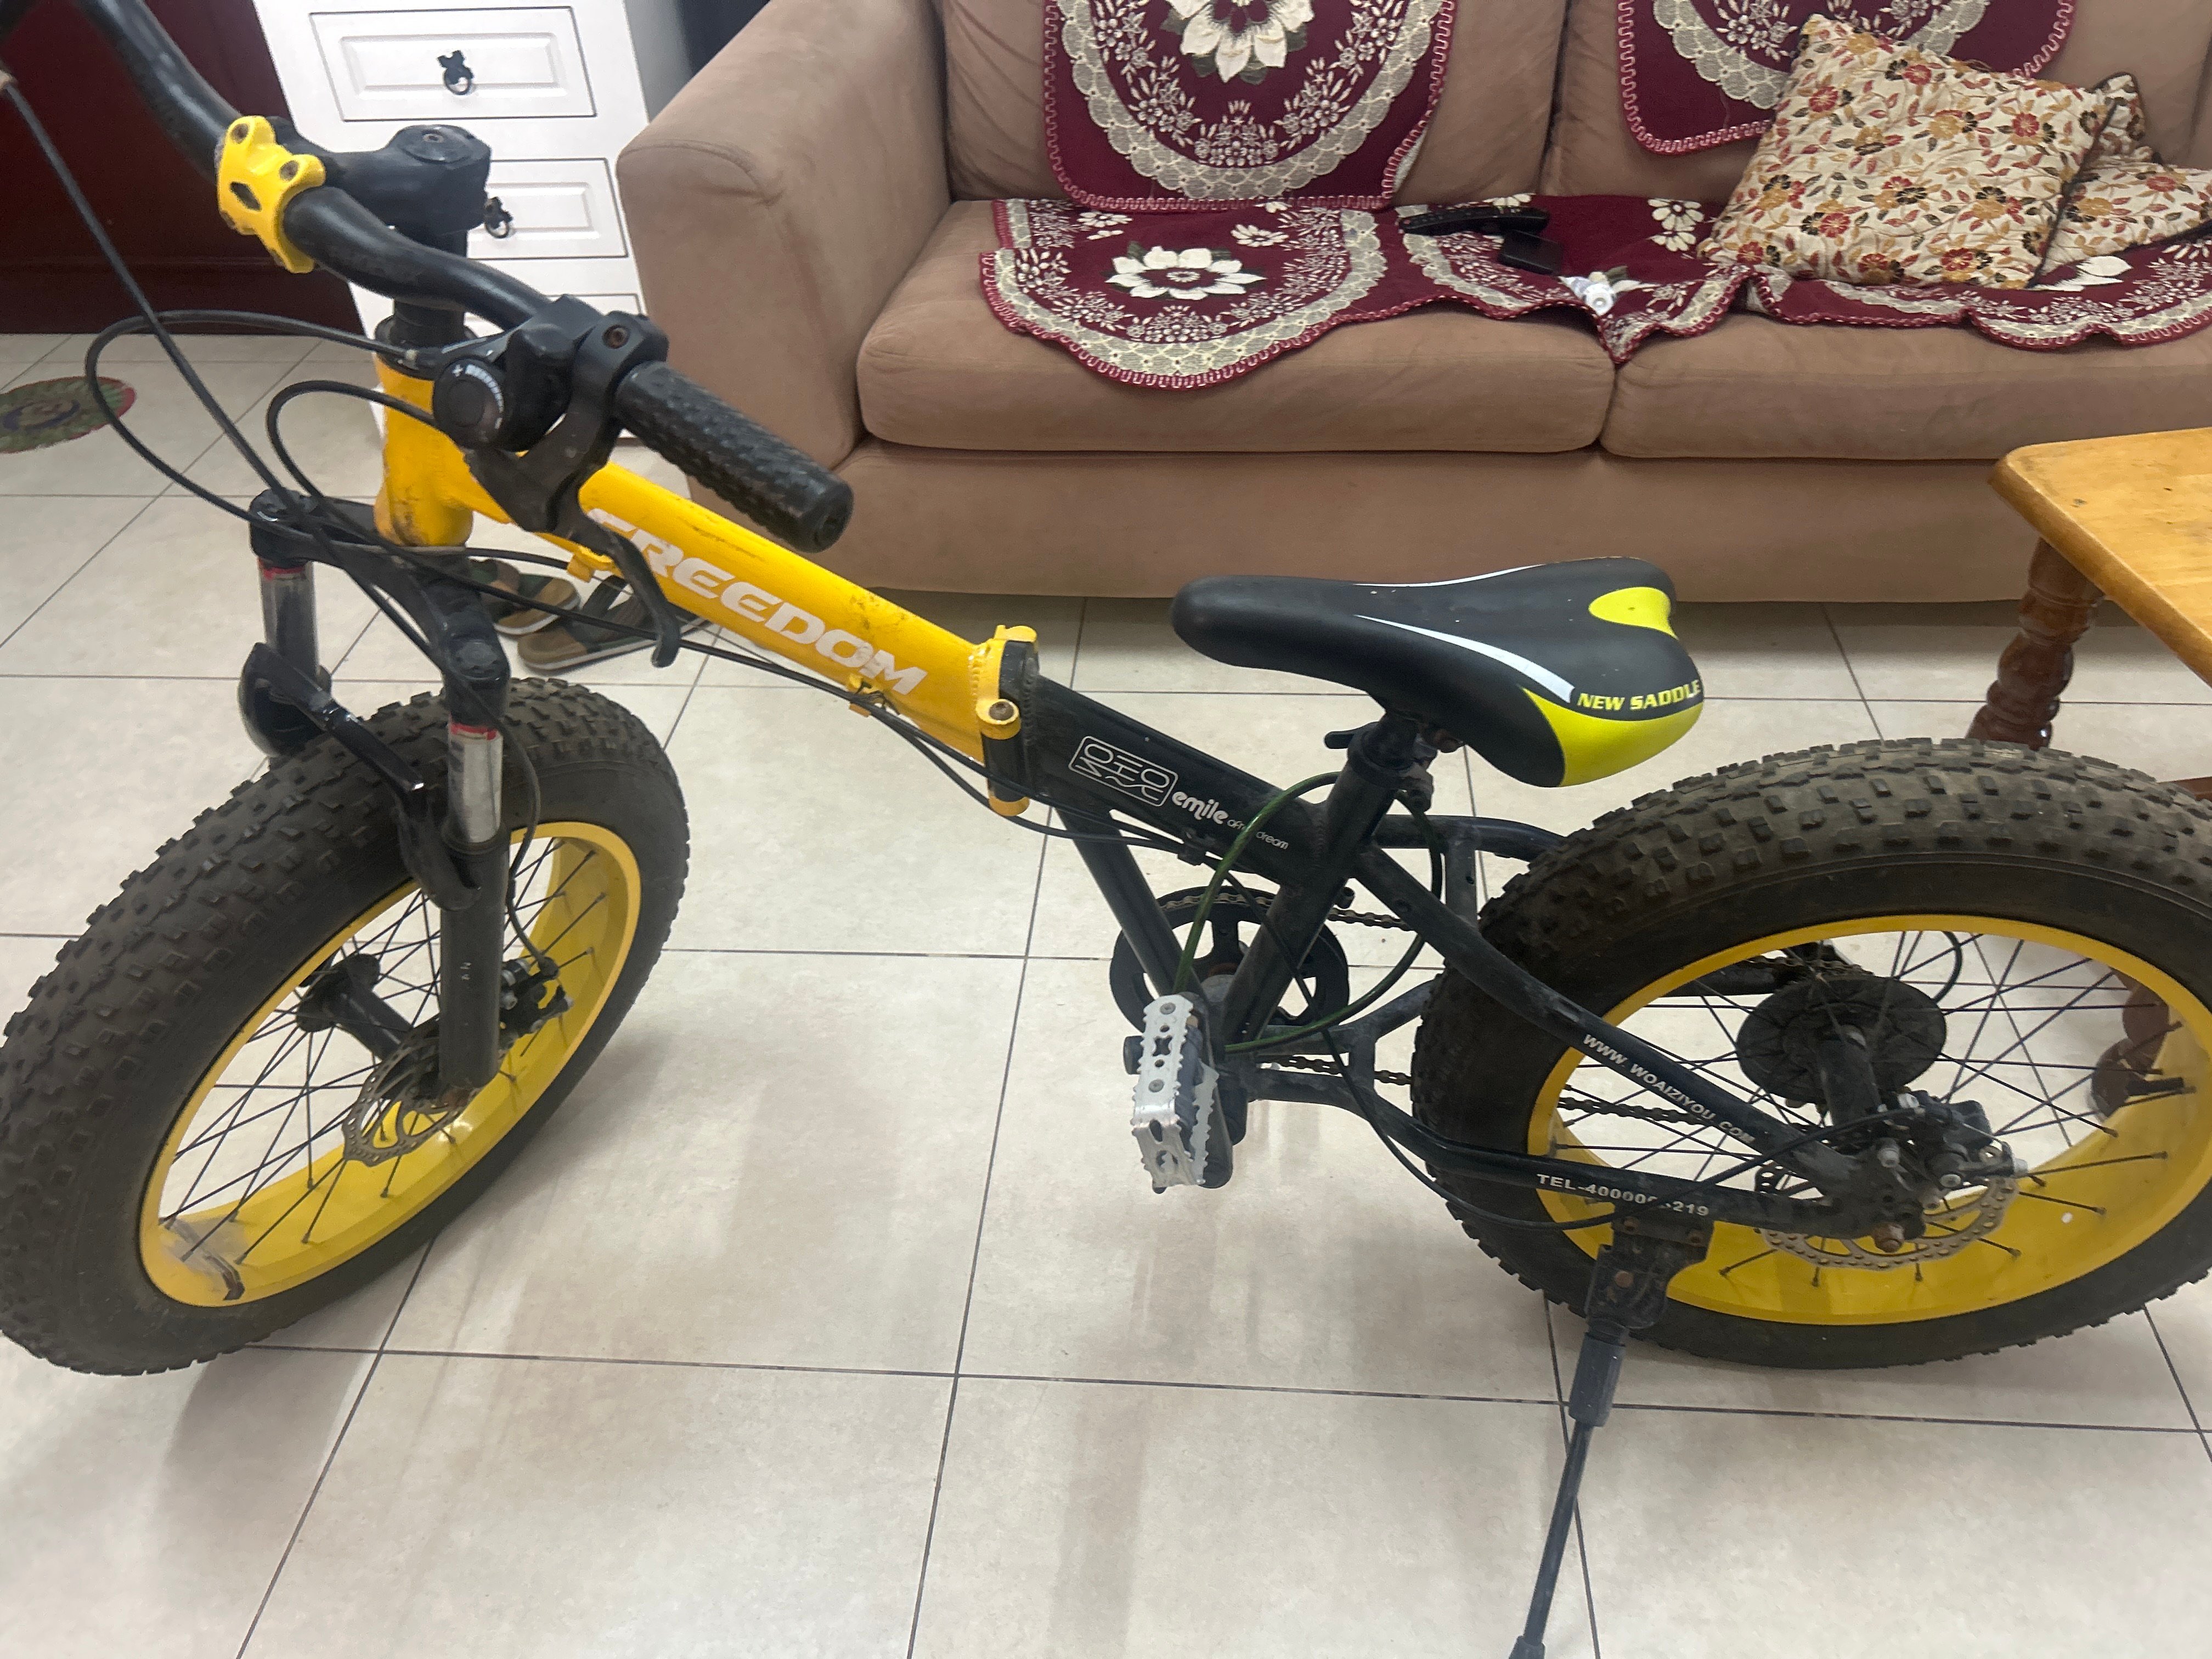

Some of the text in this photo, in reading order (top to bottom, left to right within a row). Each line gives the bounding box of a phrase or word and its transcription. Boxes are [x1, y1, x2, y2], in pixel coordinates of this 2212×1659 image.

[1577, 679, 1701, 710] NEW SADDLE
[1172, 791, 1229, 825] emile
